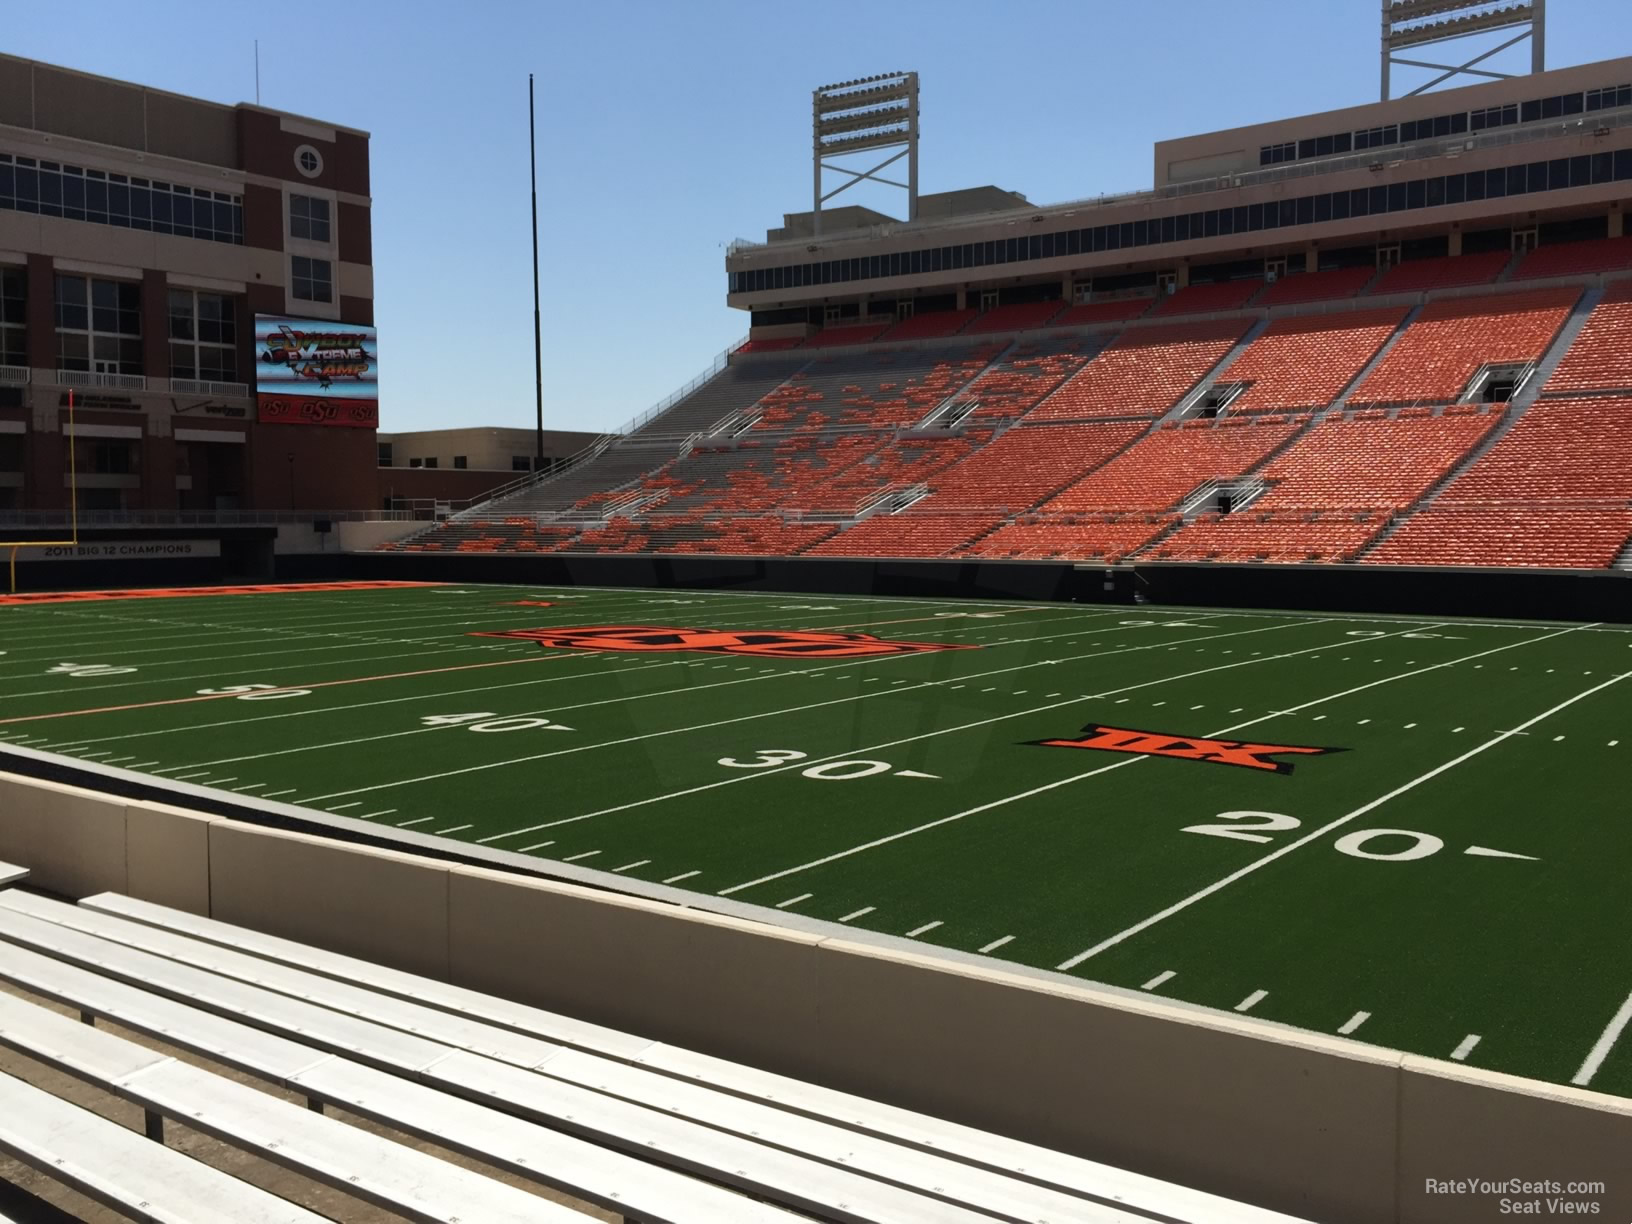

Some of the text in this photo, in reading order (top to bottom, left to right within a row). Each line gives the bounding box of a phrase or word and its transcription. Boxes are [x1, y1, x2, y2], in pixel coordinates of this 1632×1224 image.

[303, 362, 369, 378] CAMP
[300, 398, 340, 423] OSU
[44, 544, 192, 557] 2011 BIG 12 CHAMPIONS
[196, 683, 313, 701] 50
[420, 711, 551, 733] 40
[717, 749, 892, 780] 30
[1179, 810, 1444, 862] 20
